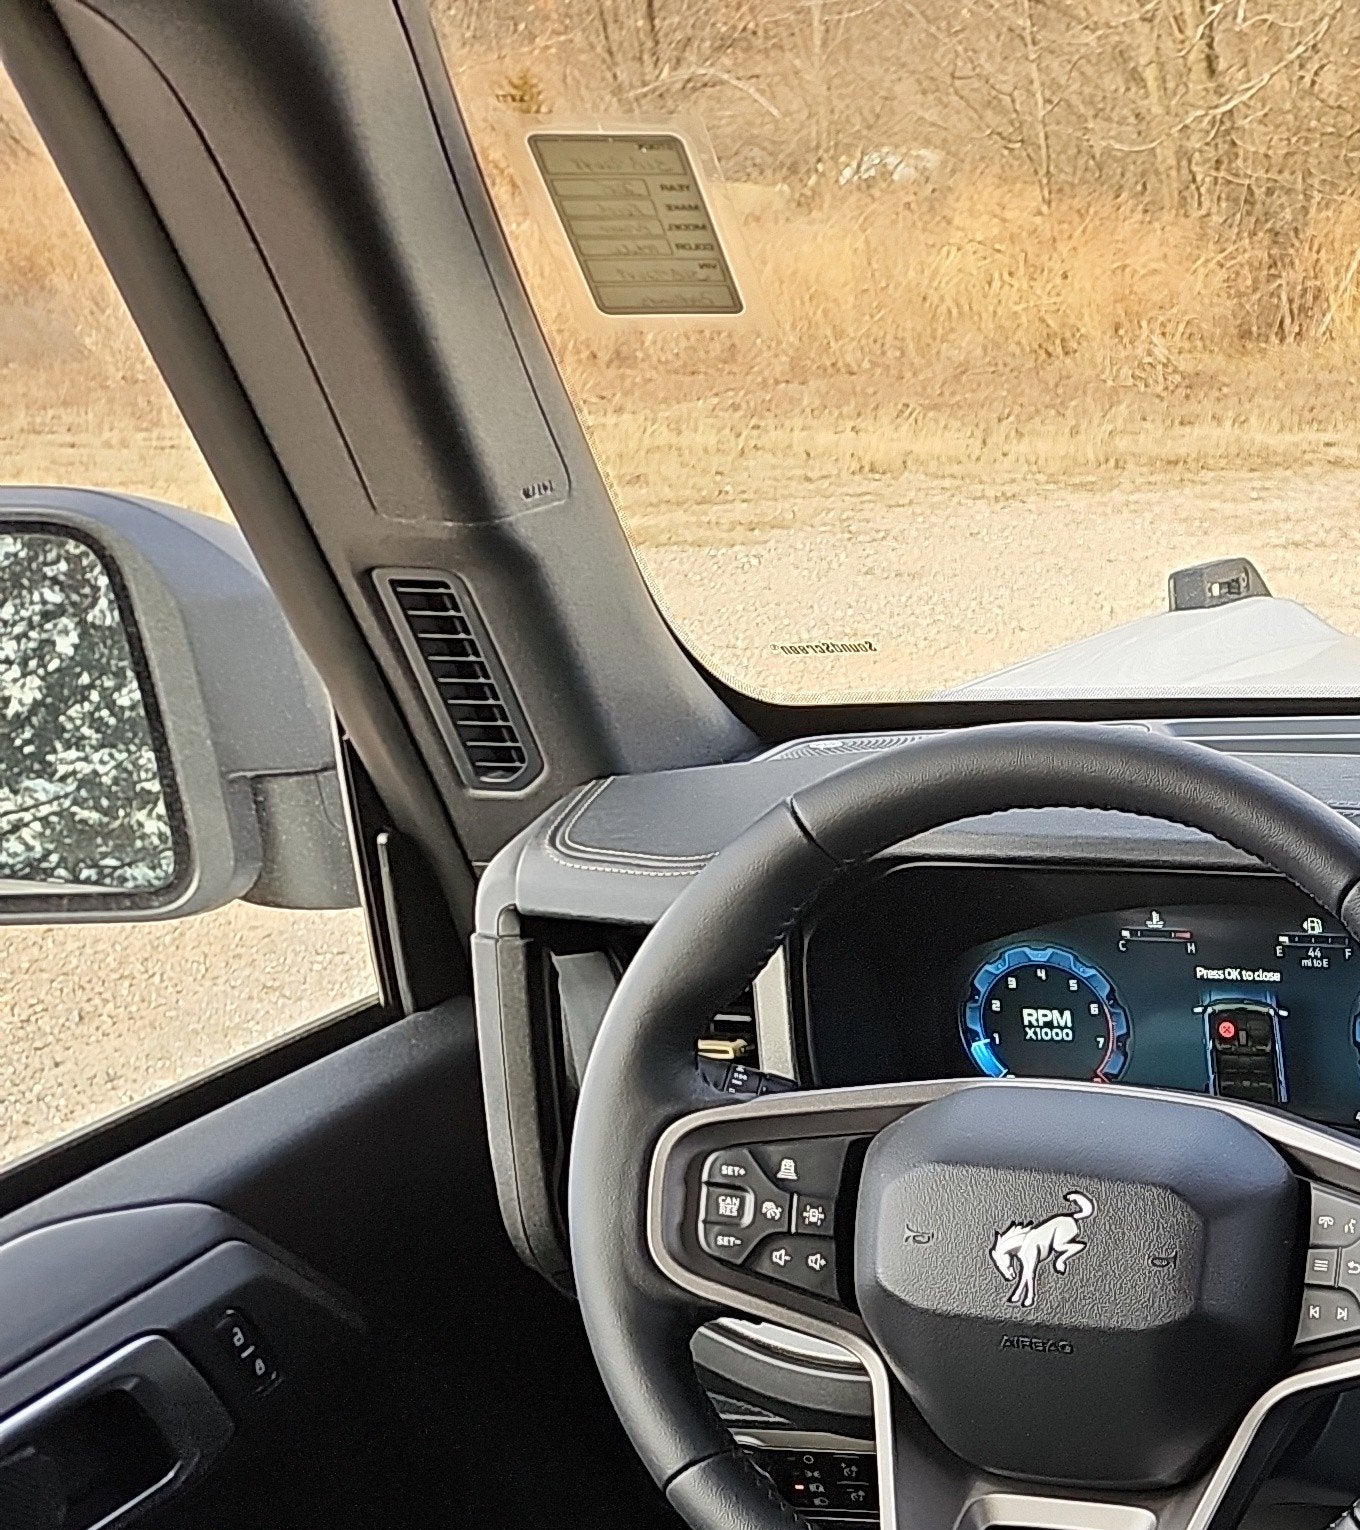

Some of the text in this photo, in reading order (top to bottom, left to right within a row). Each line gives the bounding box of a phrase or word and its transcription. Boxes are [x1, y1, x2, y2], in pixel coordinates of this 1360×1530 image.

[1119, 940, 1128, 951] C
[1187, 943, 1196, 954] H
[1276, 946, 1284, 957] E
[1307, 947, 1322, 958] 44
[1345, 949, 1352, 960] F
[1037, 969, 1046, 981] 4
[1196, 967, 1281, 982] Press OK to close
[1069, 979, 1078, 991] 5
[991, 1000, 1001, 1012] 2
[1090, 1003, 1099, 1015] 6
[1022, 1008, 1073, 1028] RPM
[1025, 1027, 1073, 1041] X1000
[1096, 1037, 1105, 1049] 7
[718, 1196, 740, 1207] CAN
